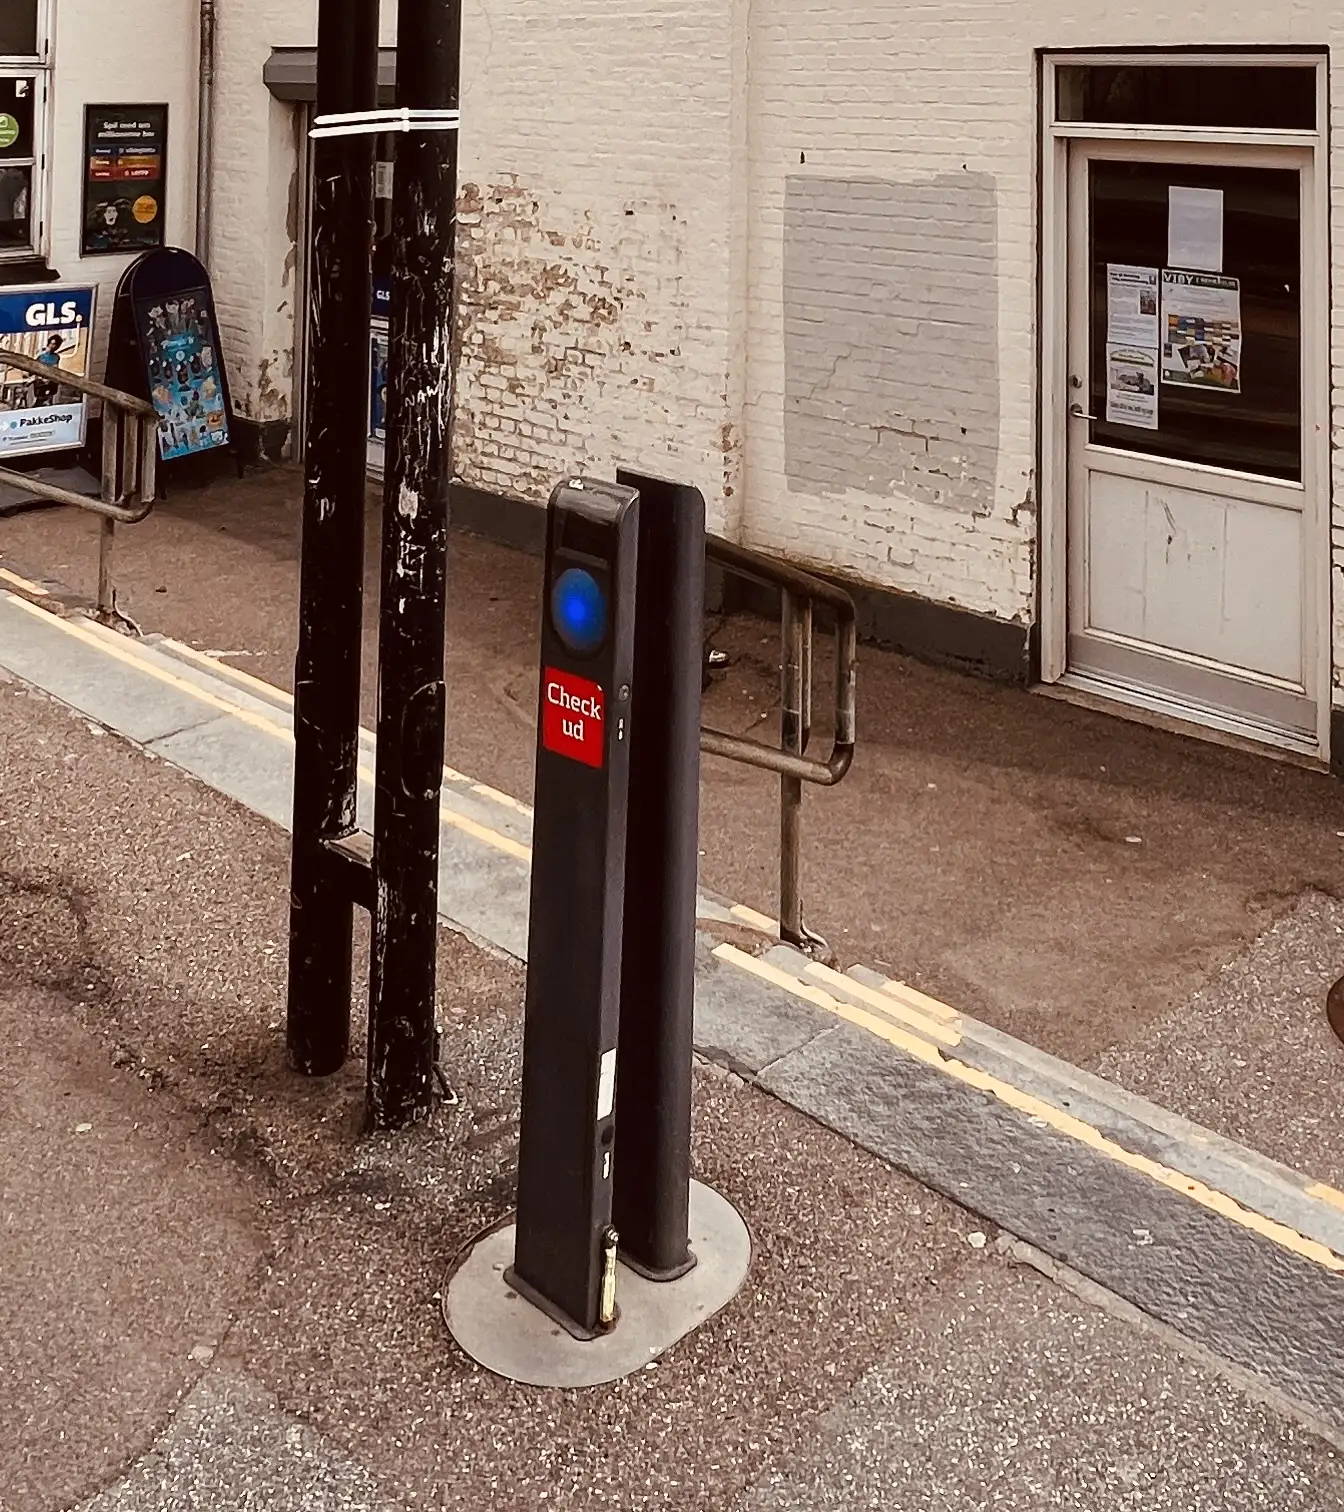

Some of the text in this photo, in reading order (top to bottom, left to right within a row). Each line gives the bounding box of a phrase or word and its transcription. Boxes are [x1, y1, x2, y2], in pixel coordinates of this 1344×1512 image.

[19, 414, 73, 428] PakkeShop
[547, 682, 602, 721] Check
[562, 718, 584, 741] ud
